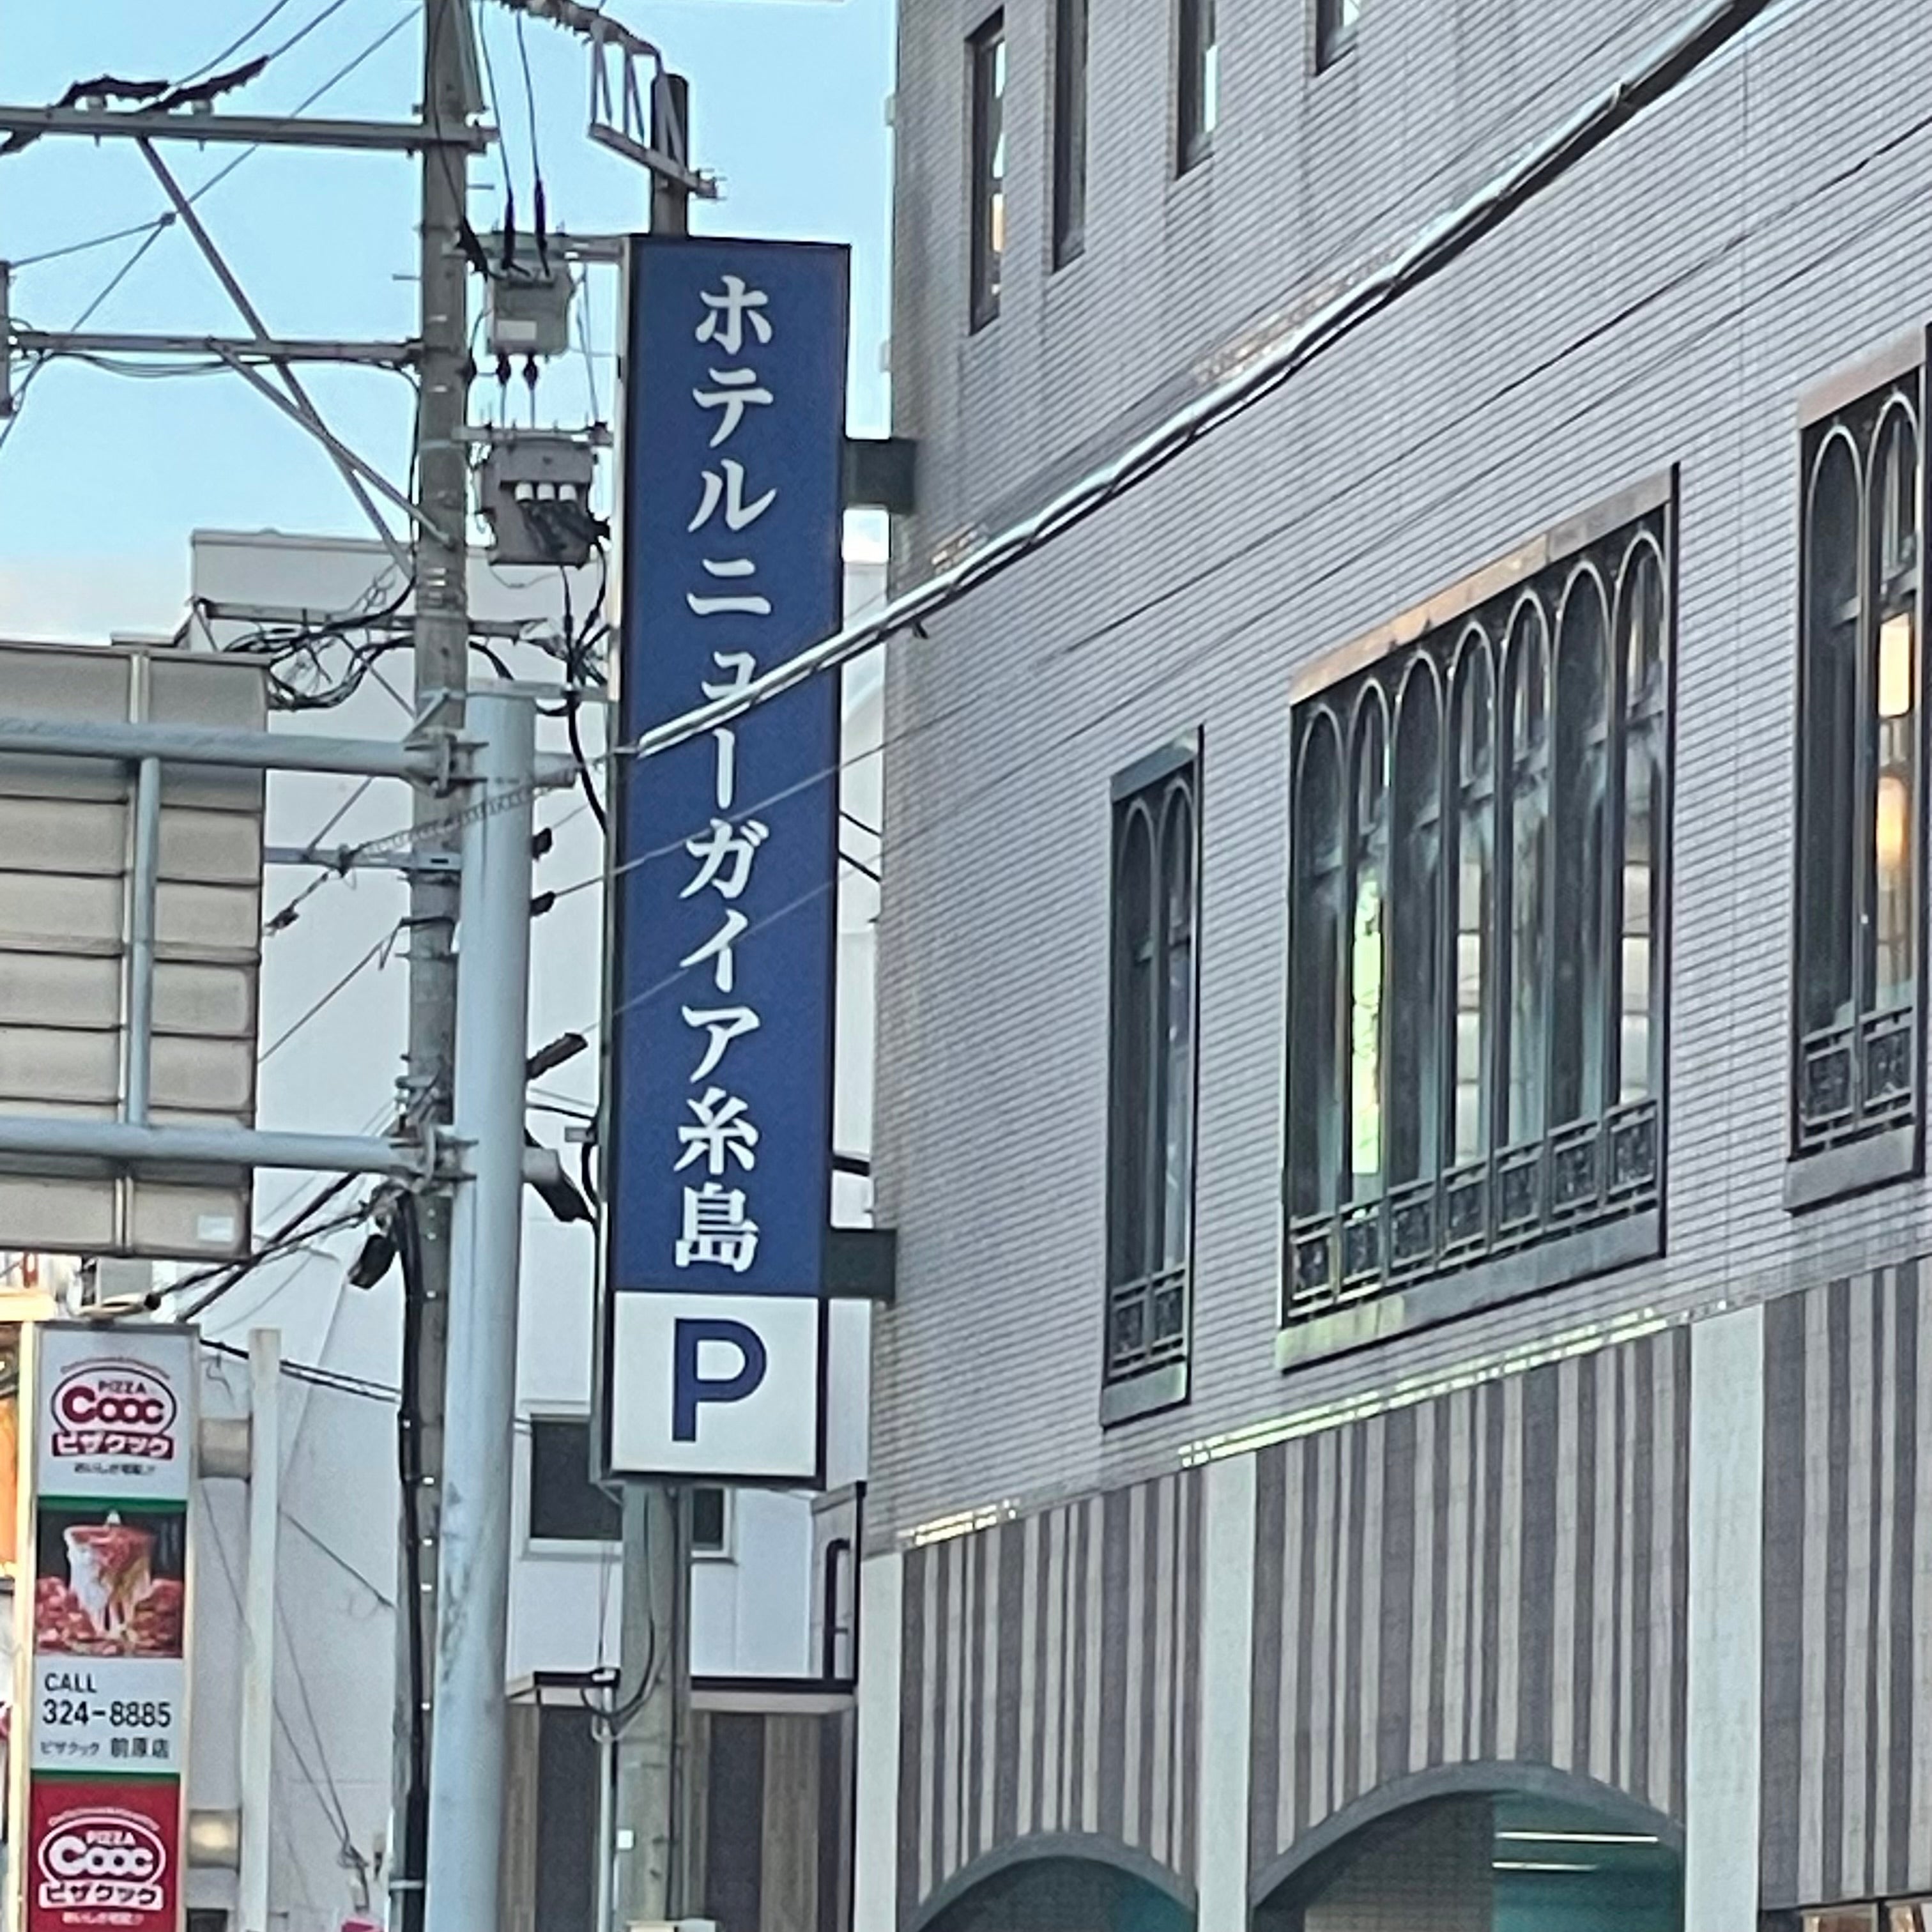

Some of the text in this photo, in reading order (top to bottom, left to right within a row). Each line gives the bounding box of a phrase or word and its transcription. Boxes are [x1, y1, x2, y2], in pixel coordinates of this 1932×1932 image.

[674, 275, 778, 1272] ホテルニューガイア糸島
[98, 1380, 147, 1394] PIZZA
[671, 1317, 767, 1442] P
[44, 1673, 97, 1693] CALL
[42, 1698, 171, 1728] 324-8885
[40, 1740, 100, 1756] ピザクック
[46, 1882, 157, 1905] ピザクック
